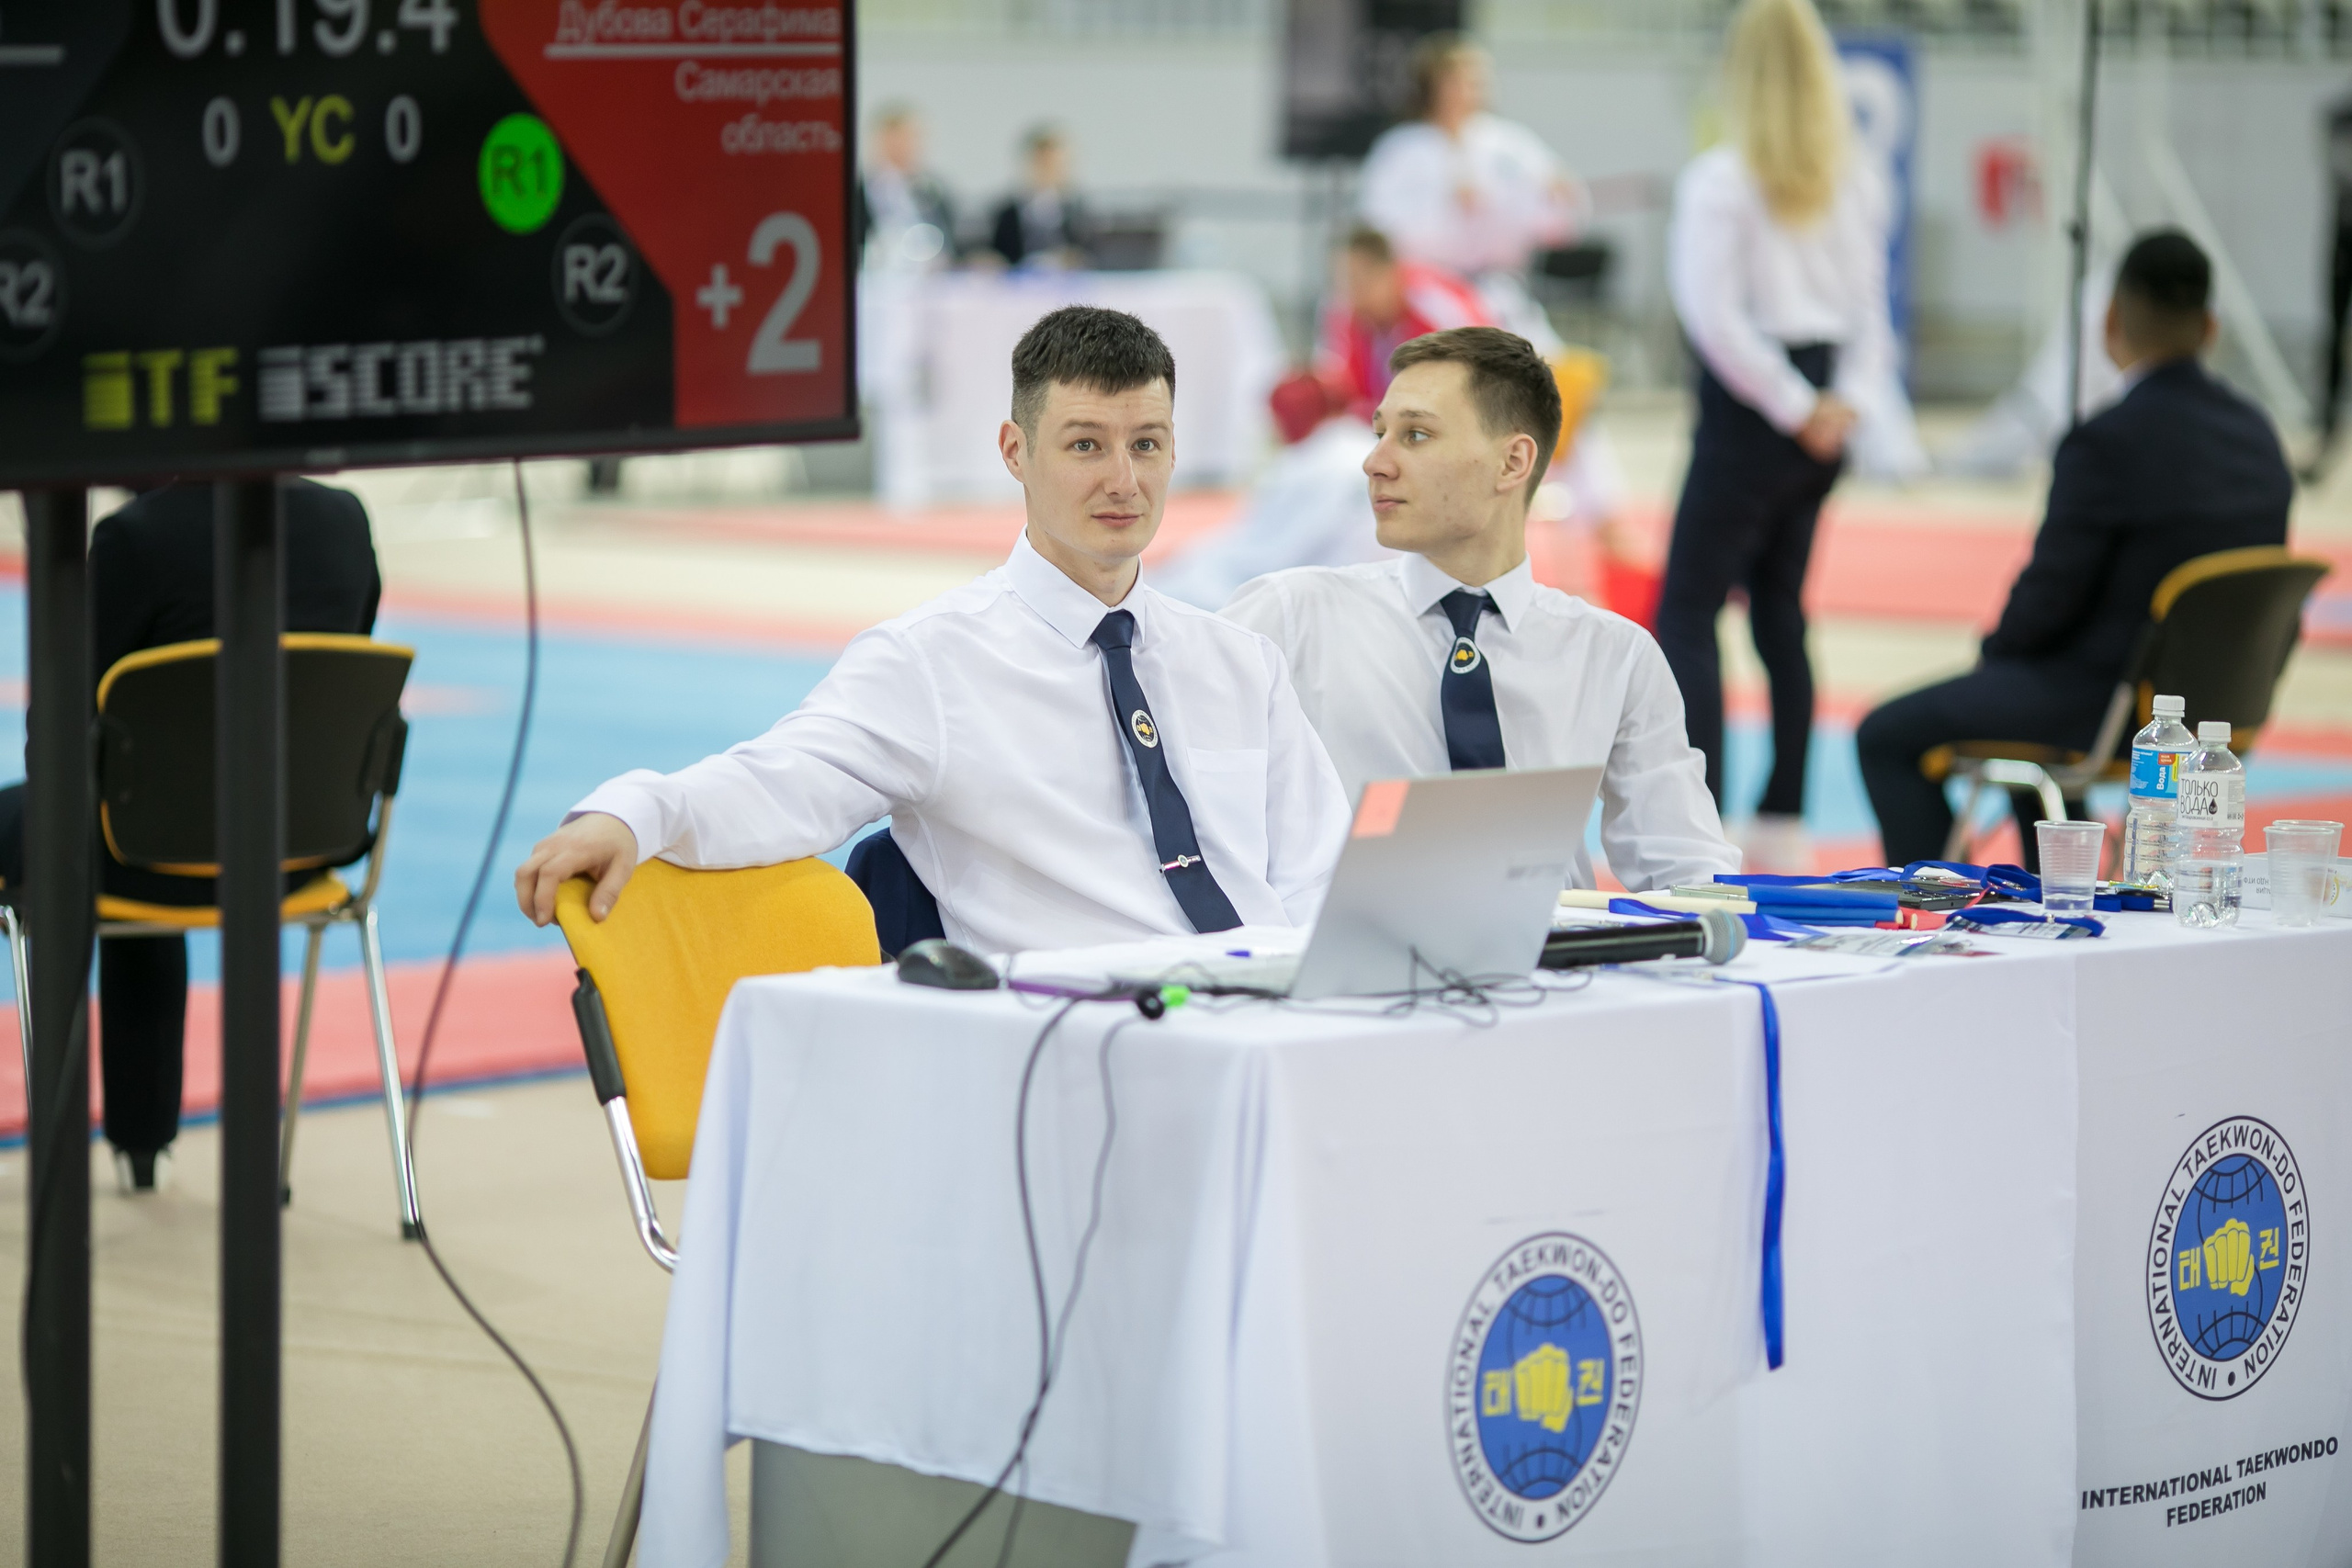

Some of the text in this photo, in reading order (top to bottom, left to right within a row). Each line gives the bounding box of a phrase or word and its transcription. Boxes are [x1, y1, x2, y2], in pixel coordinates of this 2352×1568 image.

[202, 95, 422, 167] 0 YC 0
[721, 113, 842, 155] область
[61, 150, 127, 214] R1
[489, 144, 548, 199] R1
[562, 243, 628, 304] R2
[2156, 766, 2166, 790] Вода
[2180, 778, 2219, 797] ТОЛЬКО
[2180, 795, 2209, 816] ВОДА
[2152, 1124, 2304, 1390] INTERNATIONAL TAEKWON-DO FEDERATION
[1452, 1301, 1524, 1529] INTERNATIONAL
[1555, 1332, 1637, 1521] FEDERATION
[2081, 1436, 2339, 1509] INTERNATIONAL TAEKWONDO
[2166, 1482, 2267, 1528] FEDERATION
